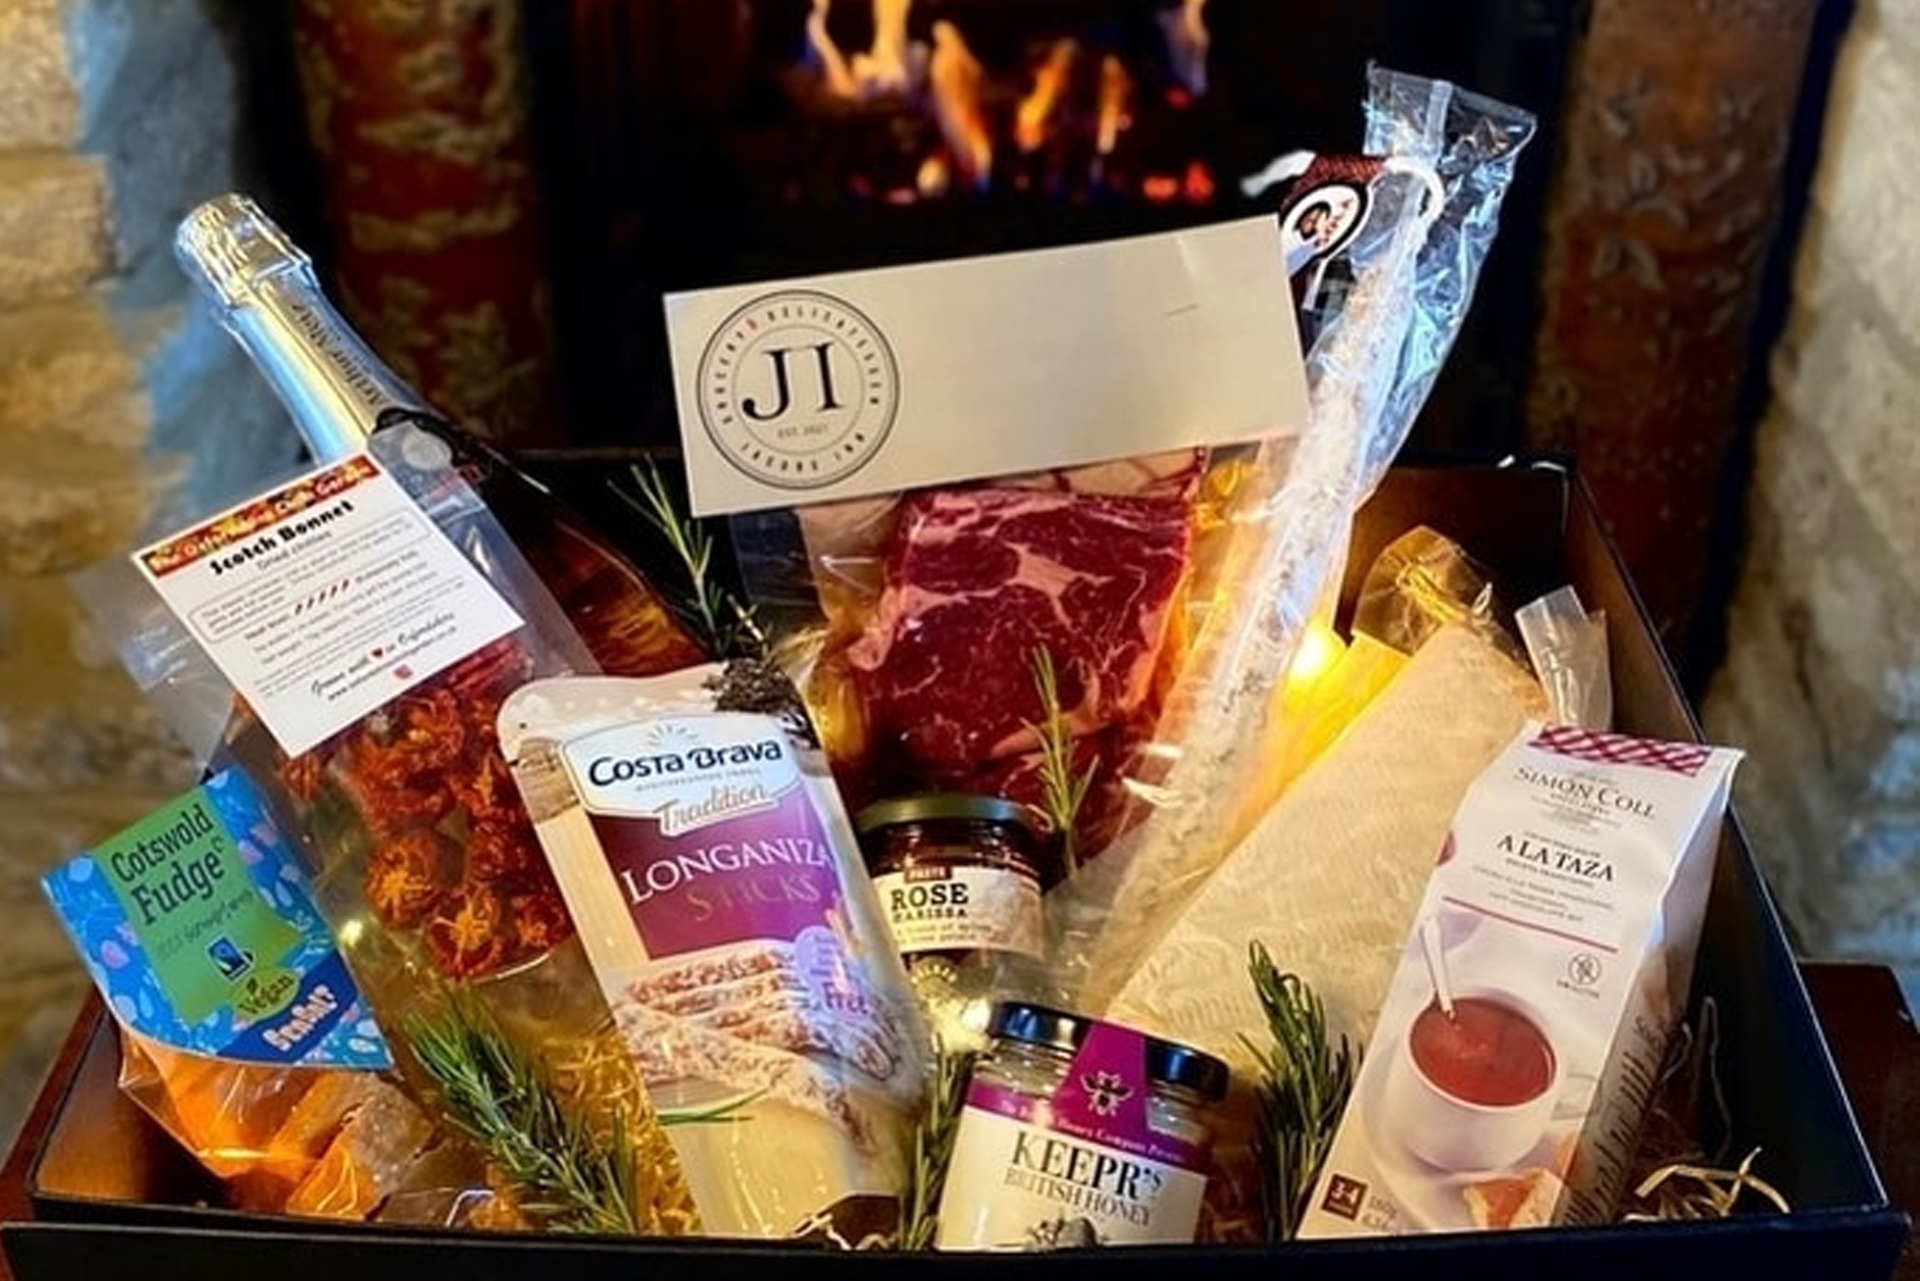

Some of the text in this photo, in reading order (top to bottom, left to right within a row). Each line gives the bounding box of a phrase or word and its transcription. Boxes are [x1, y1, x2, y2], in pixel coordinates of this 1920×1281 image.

[742, 342, 846, 421] JI
[208, 498, 356, 575] Scotch Bonnet
[588, 739, 783, 787] Costa Brava
[111, 803, 214, 884] Cotswold
[1496, 833, 1512, 851] A
[1518, 840, 1546, 864] LA
[1555, 851, 1612, 881] TAZA
[131, 857, 225, 925] Fudge
[687, 874, 820, 921] STICKS
[890, 883, 969, 911] ROSE
[1004, 1167, 1154, 1226] BRITISH HONEY
